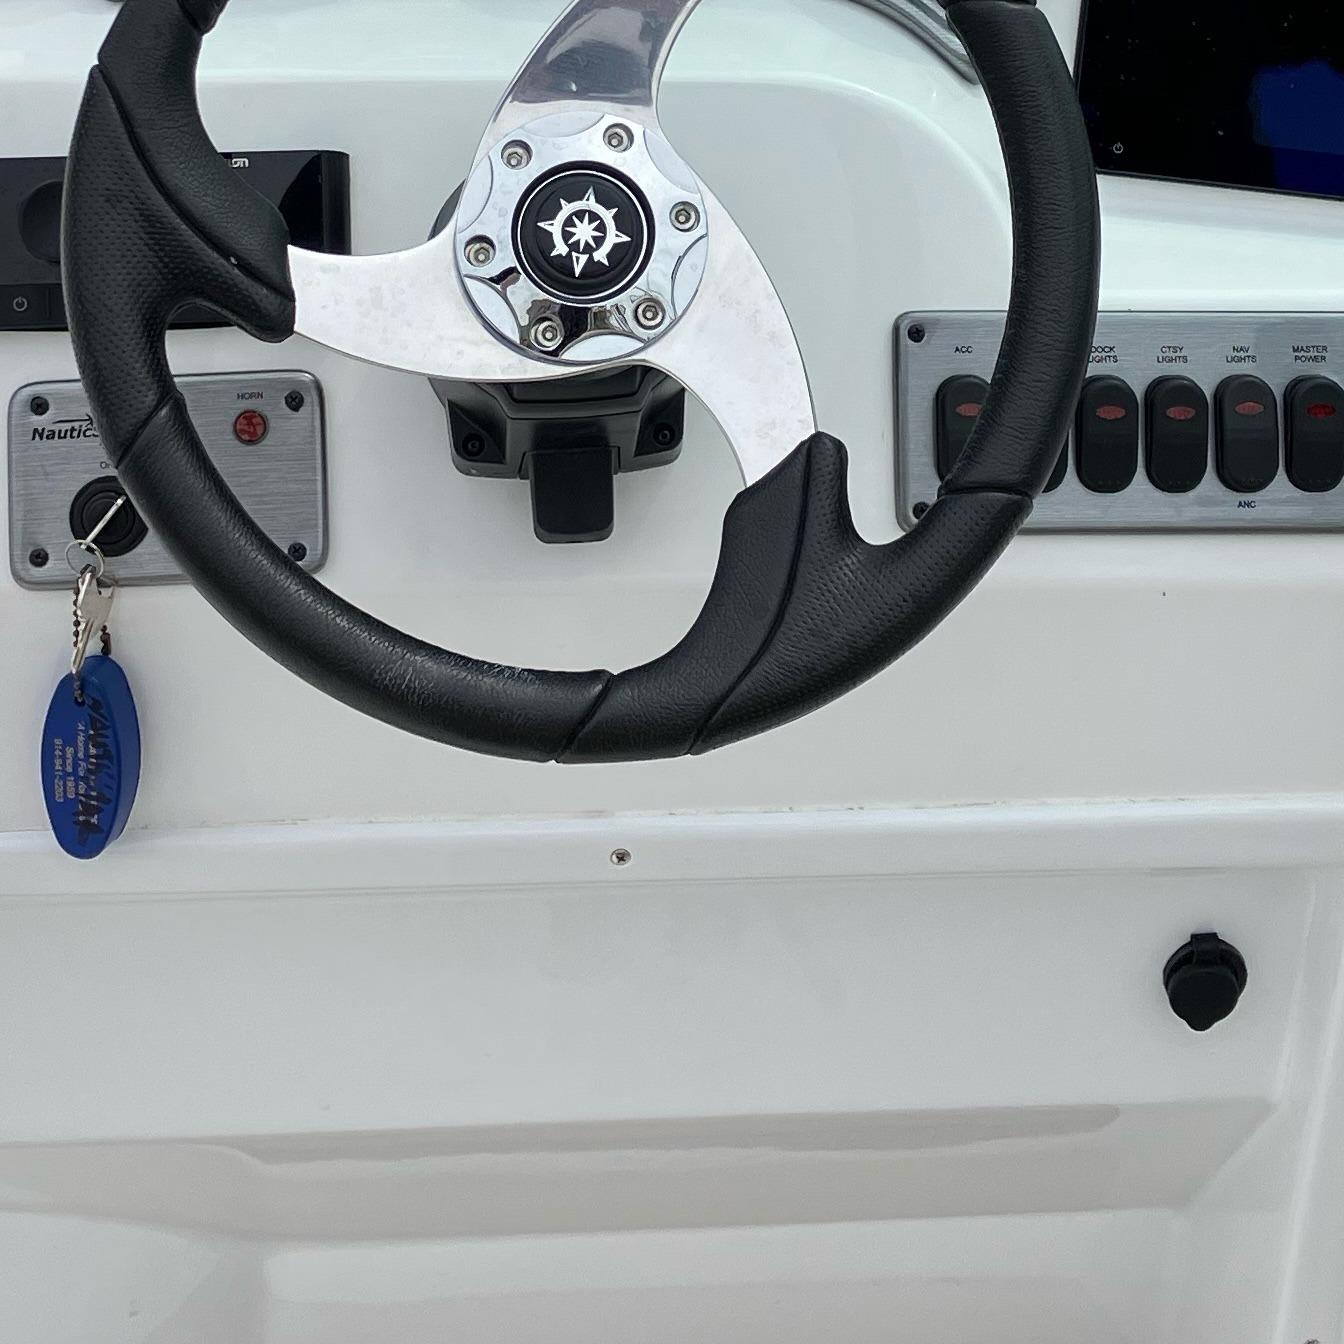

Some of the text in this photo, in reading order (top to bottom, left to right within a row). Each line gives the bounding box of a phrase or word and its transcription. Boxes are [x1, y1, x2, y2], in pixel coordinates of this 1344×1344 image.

[954, 346, 973, 354] ACC
[1090, 345, 1116, 354] DOCK
[1160, 345, 1184, 354] CTSY
[1232, 345, 1250, 354] NAV
[1292, 345, 1328, 354] MASTER
[1088, 355, 1119, 364] LIGHTS
[1157, 355, 1188, 364] LIGHTS
[1226, 355, 1256, 364] LIGHTS
[1294, 355, 1327, 363] POWER
[236, 392, 263, 400] HORN
[1237, 500, 1256, 508] ANC
[77, 732, 85, 758] Home
